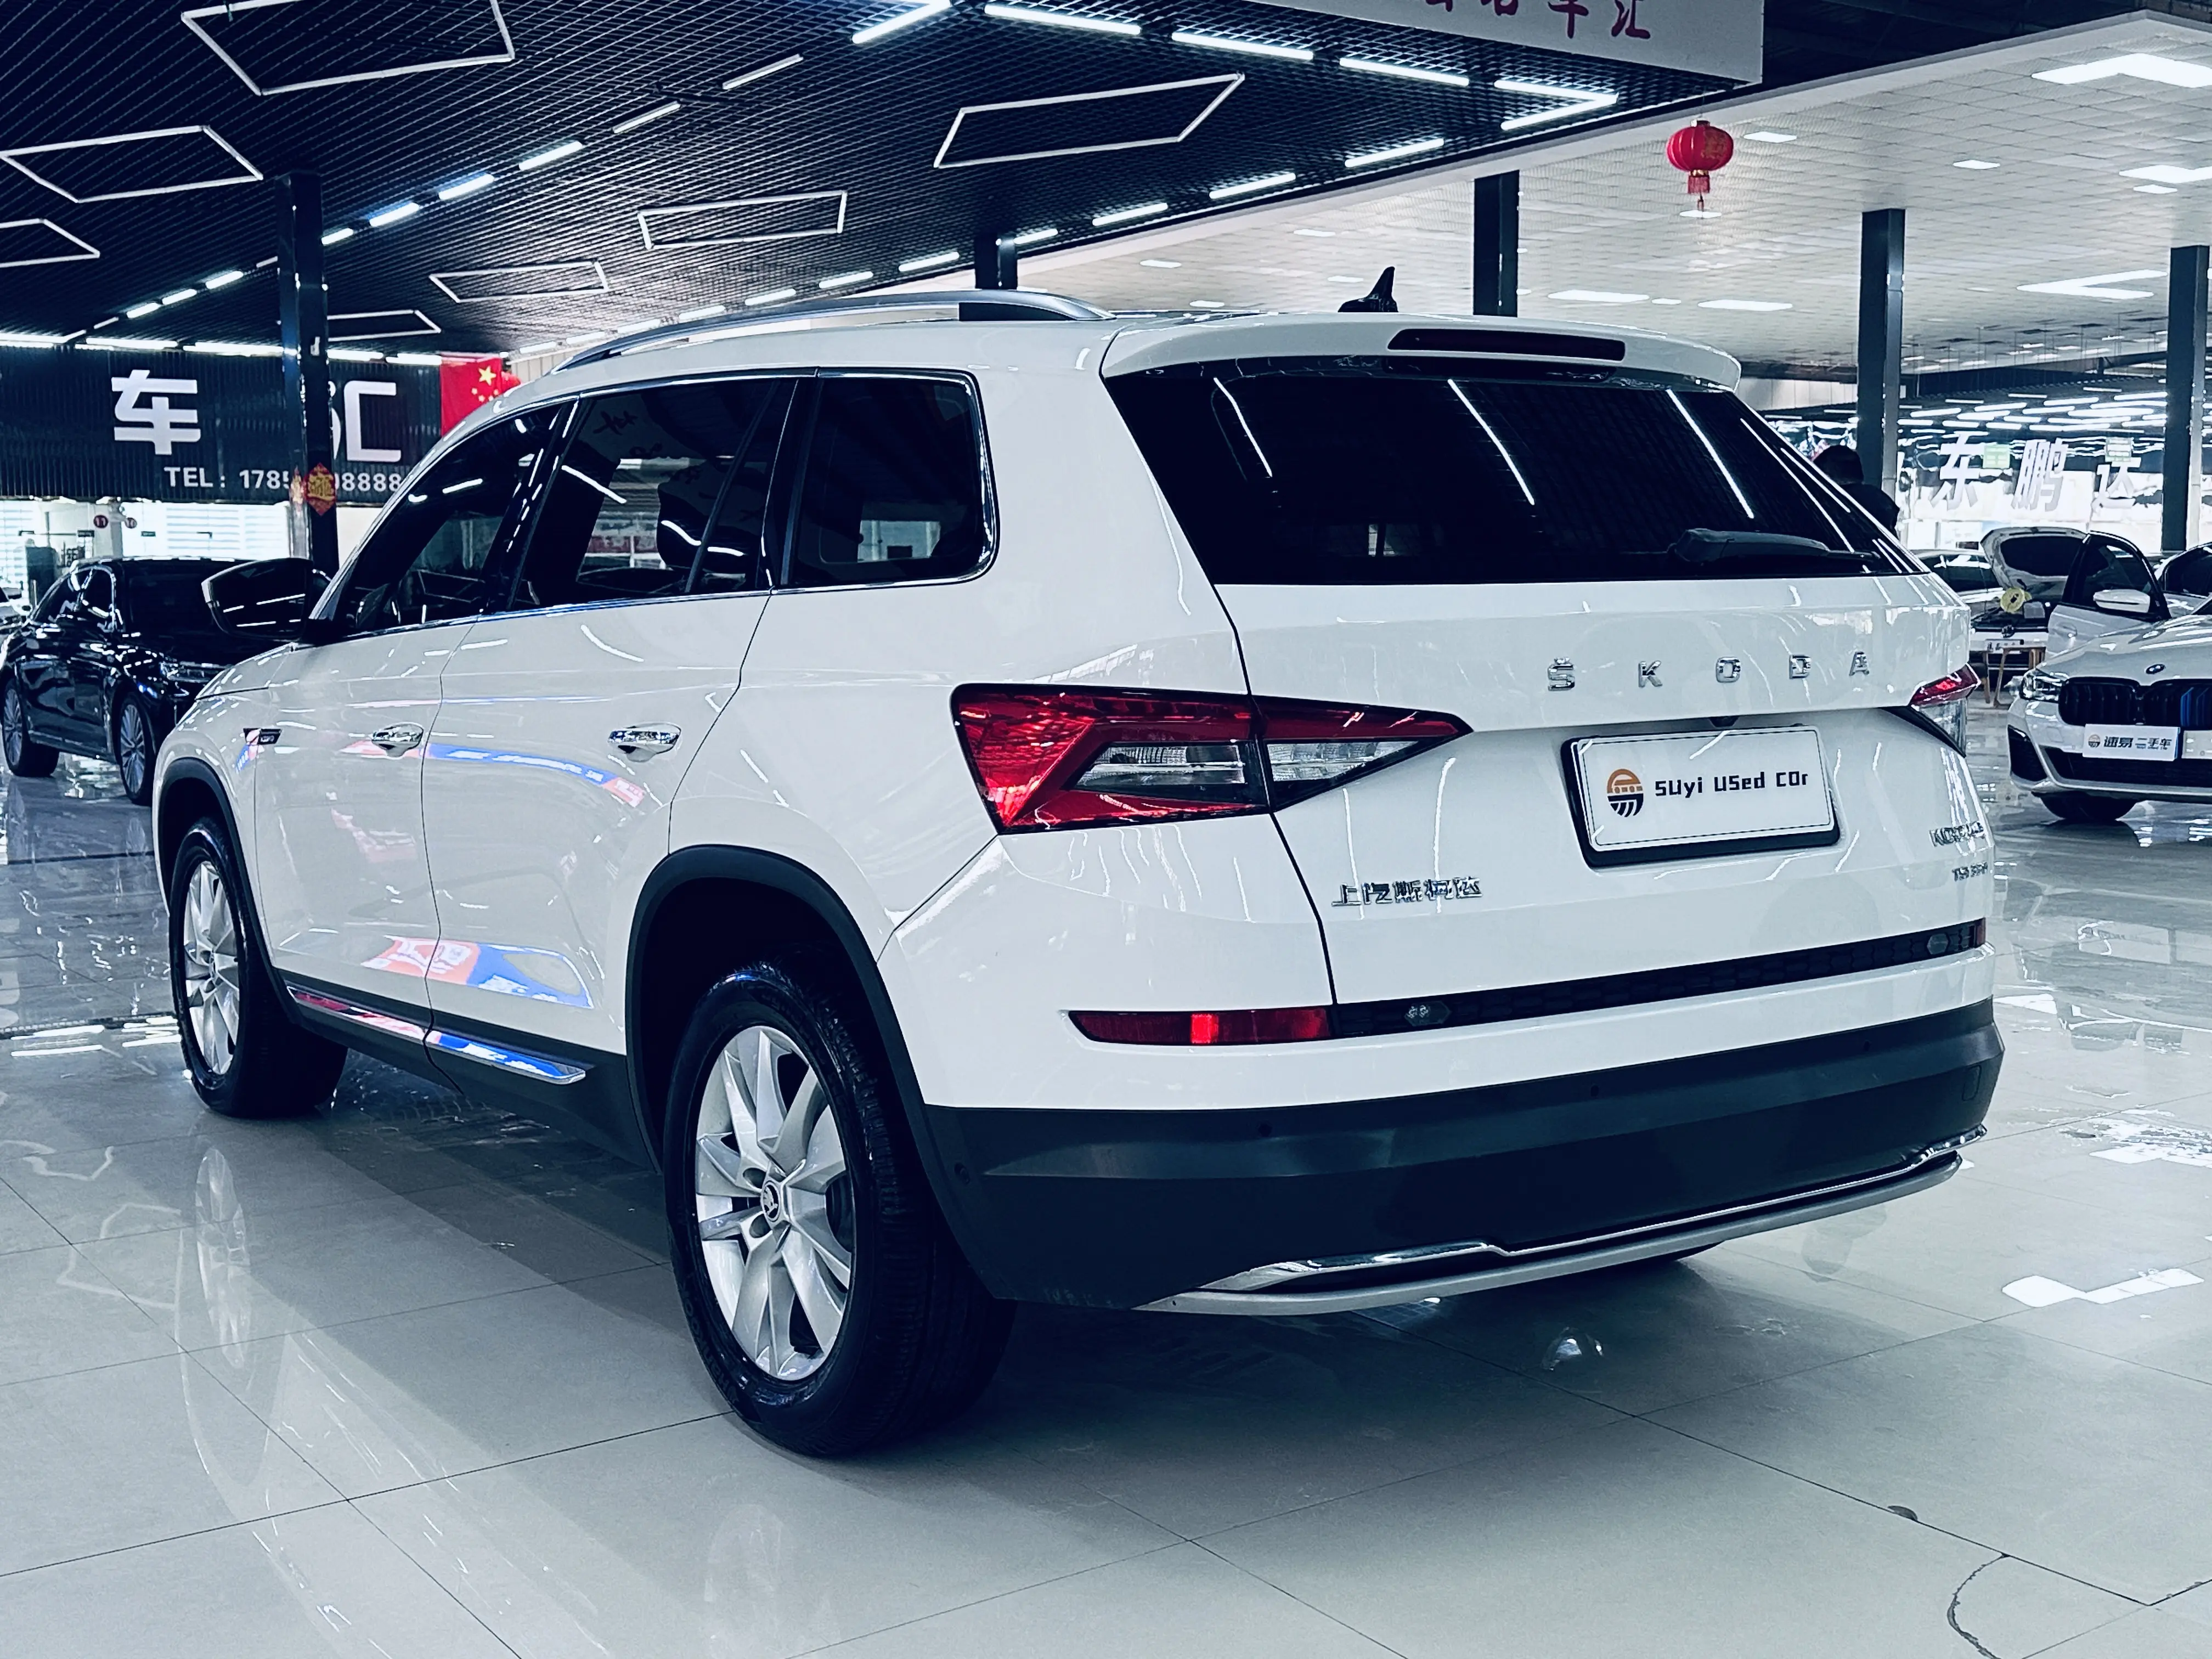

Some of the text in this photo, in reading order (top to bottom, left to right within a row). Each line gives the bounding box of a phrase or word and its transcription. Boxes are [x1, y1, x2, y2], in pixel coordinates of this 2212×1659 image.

[1930, 430, 2142, 512] 东鹏达
[1331, 876, 1483, 907] 上汽斯柯达
